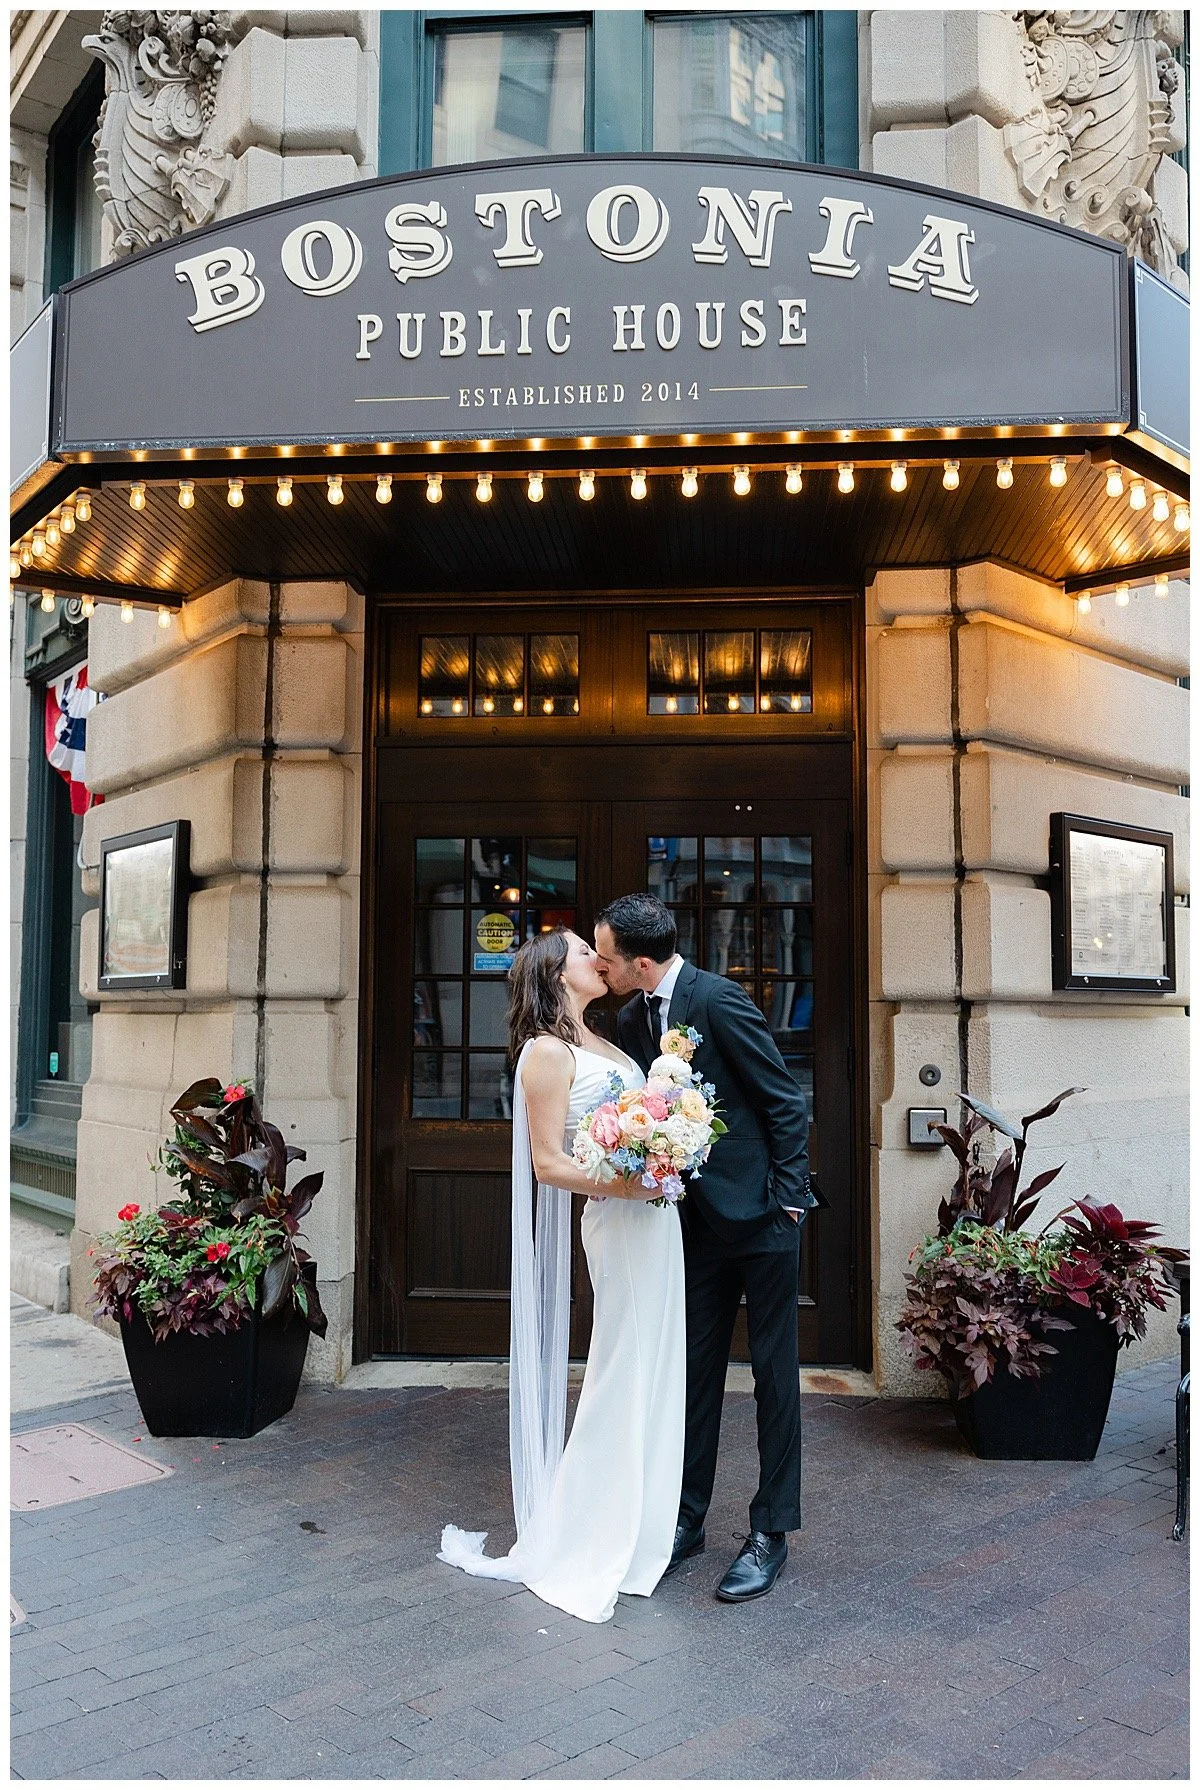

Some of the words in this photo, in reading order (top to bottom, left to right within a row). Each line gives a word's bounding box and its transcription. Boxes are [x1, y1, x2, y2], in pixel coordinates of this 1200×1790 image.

[175, 184, 979, 333] BOSTONIA
[355, 306, 572, 359] PUBLIC
[613, 299, 808, 351] HOUSE
[458, 384, 626, 407] ESTABLISHED
[641, 382, 701, 402] 2014
